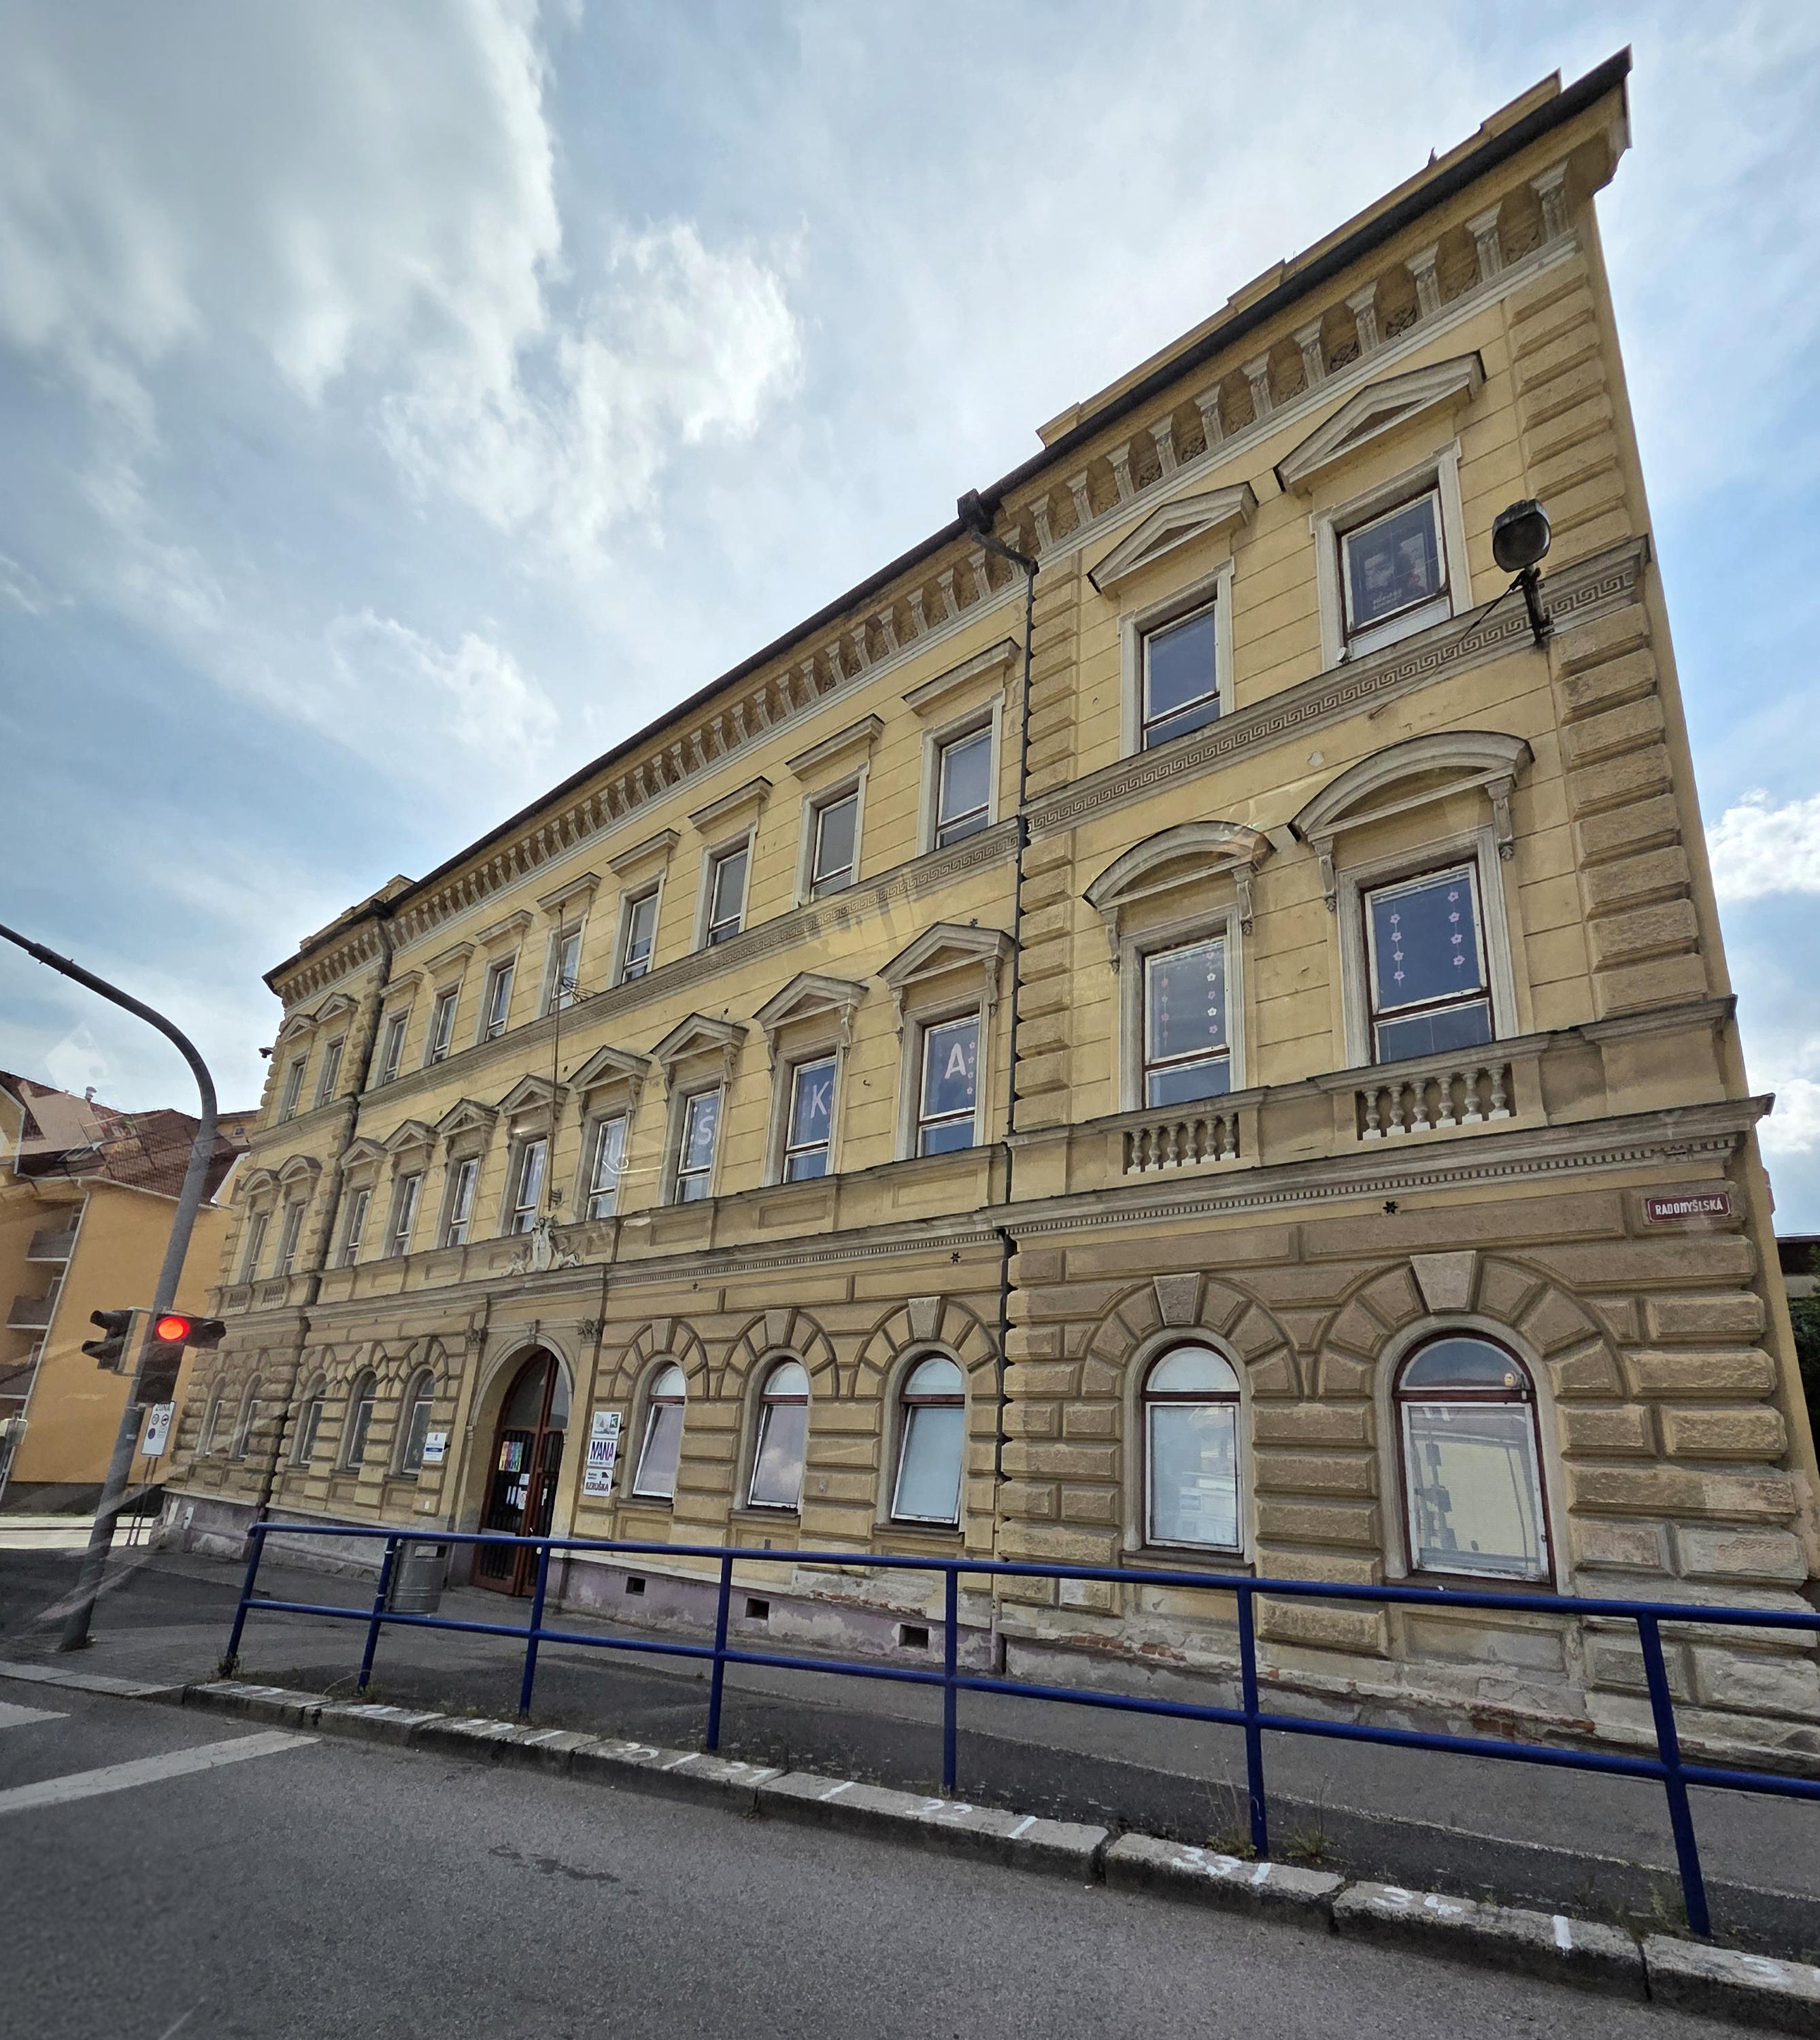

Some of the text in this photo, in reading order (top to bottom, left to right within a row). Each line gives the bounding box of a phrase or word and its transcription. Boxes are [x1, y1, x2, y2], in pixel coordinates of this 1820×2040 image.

[698, 1108, 715, 1146] Š
[810, 1080, 831, 1119] K
[944, 1042, 967, 1080] A
[1655, 1197, 1723, 1215] RADOMYŠLSKÁ
[1172, 1845, 1243, 1875] 33
